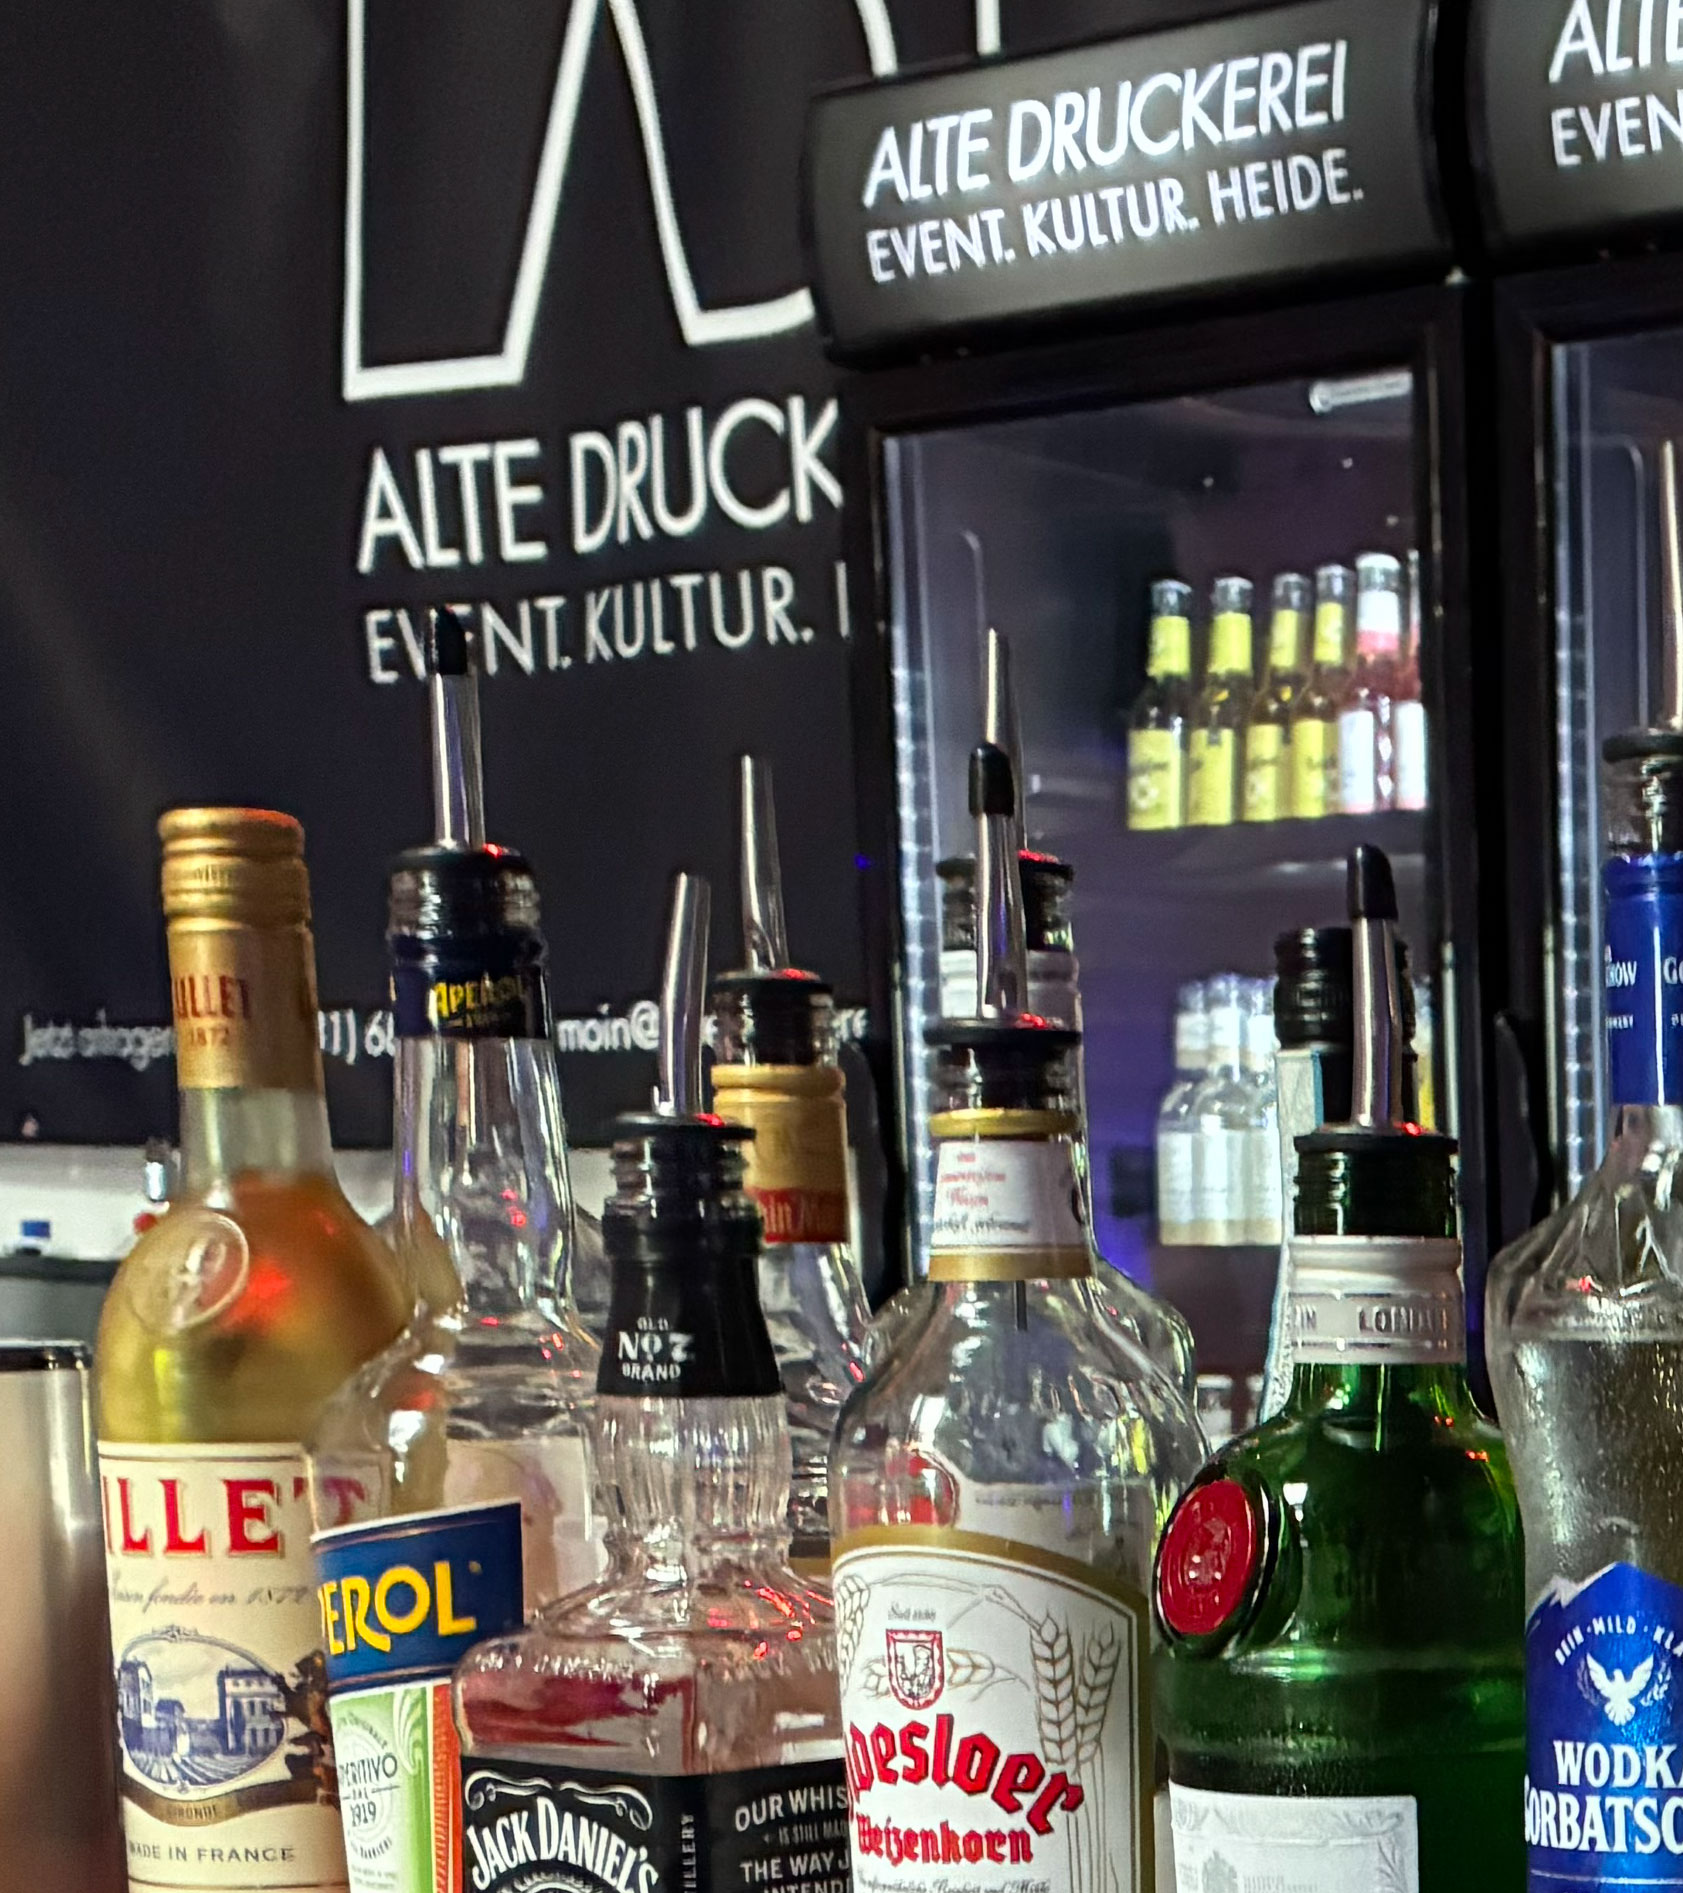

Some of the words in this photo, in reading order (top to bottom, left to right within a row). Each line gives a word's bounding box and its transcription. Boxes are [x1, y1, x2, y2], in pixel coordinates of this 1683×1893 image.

[862, 109, 993, 209] ALTE
[1007, 39, 1348, 184] DRUCKEREI
[866, 208, 1015, 283] EVENT.
[1023, 177, 1198, 258] KULTUR.
[1207, 148, 1363, 226] HEIDE.
[357, 440, 548, 575] ALTE
[571, 396, 844, 554] DRUCK
[586, 567, 814, 665] KULTUR.
[1591, 1613, 1637, 1636] MILD
[735, 1792, 785, 1832] OUR
[846, 1712, 1085, 1836] desloer
[168, 1845, 188, 1862] IN
[198, 1847, 295, 1863] FRANCE
[466, 1810, 538, 1890] JACK
[739, 1856, 784, 1884] THE
[789, 1848, 835, 1878] WAY
